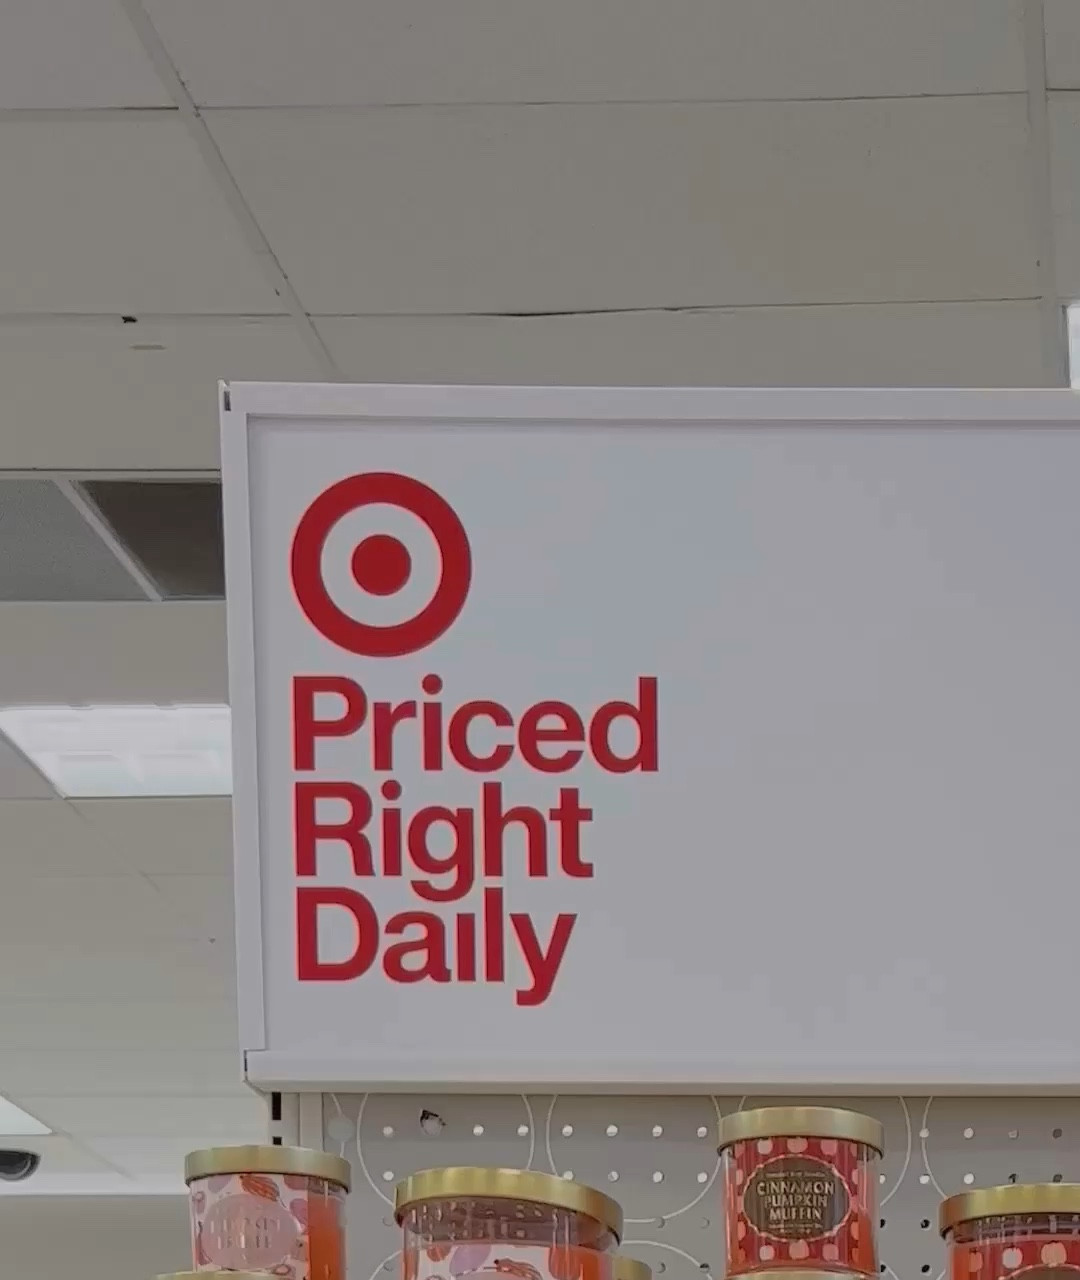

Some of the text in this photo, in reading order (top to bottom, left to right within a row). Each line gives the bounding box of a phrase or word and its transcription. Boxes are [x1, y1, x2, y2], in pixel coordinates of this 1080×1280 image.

[291, 673, 659, 774] Priced
[293, 779, 595, 902] Right
[295, 886, 578, 1007] Daily
[757, 1181, 836, 1196] CINNAMON
[764, 1194, 828, 1207] PUMPKIN
[769, 1206, 821, 1220] MUFFIN
